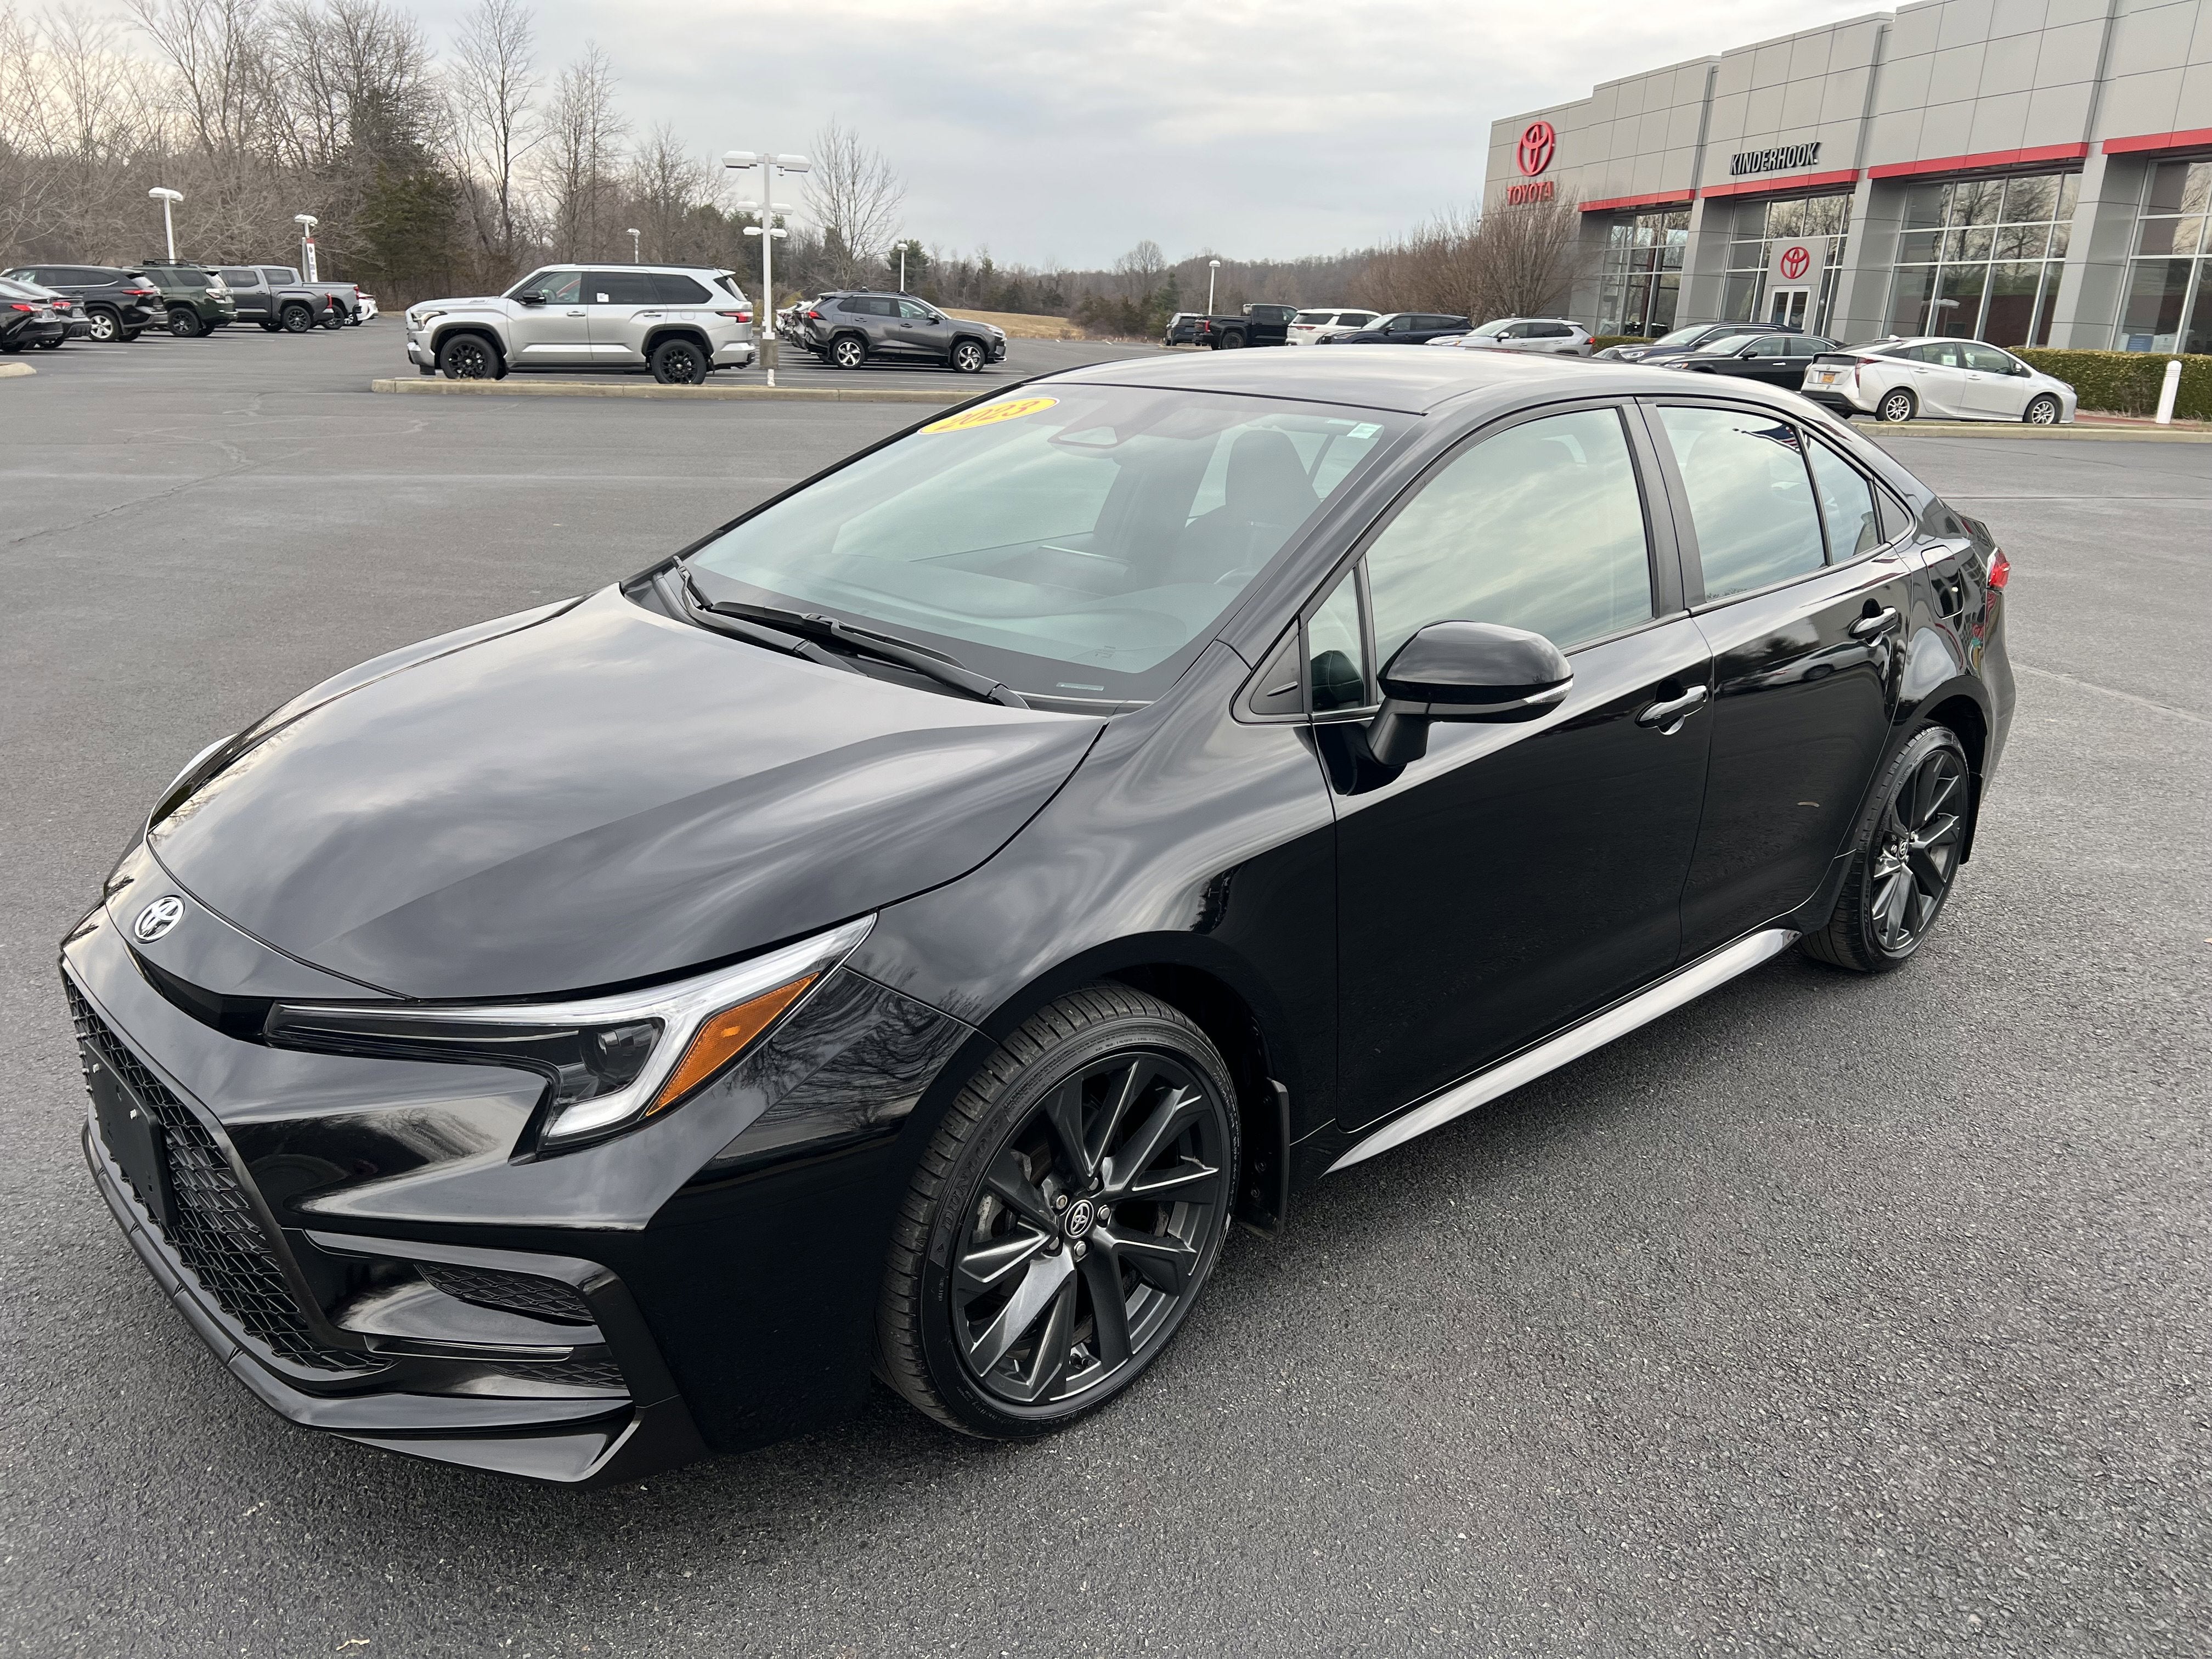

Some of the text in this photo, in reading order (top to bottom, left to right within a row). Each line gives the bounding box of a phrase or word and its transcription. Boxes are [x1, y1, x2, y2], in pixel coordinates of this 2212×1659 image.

[1730, 142, 1820, 175] KINDERHOOK
[1506, 181, 1553, 206] TOYOTA
[933, 400, 1041, 431] 2023
[941, 1118, 999, 1231] DUNLOP
